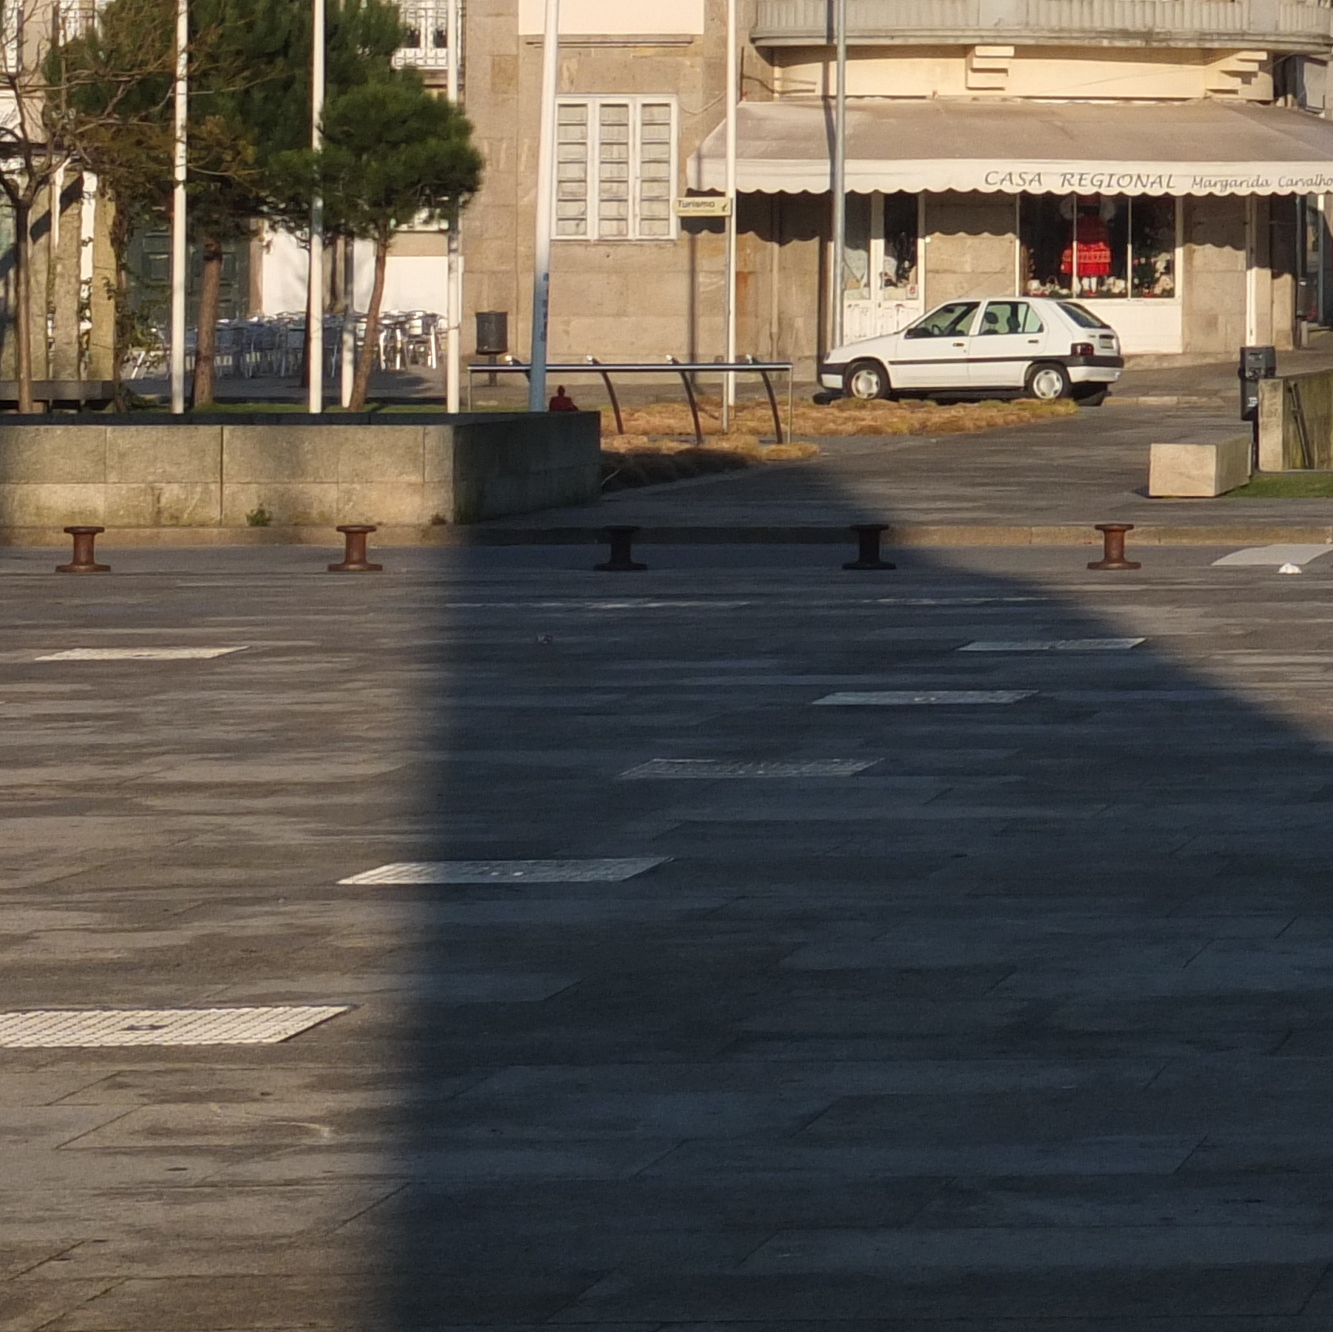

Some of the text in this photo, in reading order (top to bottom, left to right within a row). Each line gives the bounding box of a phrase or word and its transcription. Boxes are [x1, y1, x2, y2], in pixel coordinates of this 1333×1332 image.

[984, 170, 1333, 193] CASA REGIONAL Margarida Carvalho
